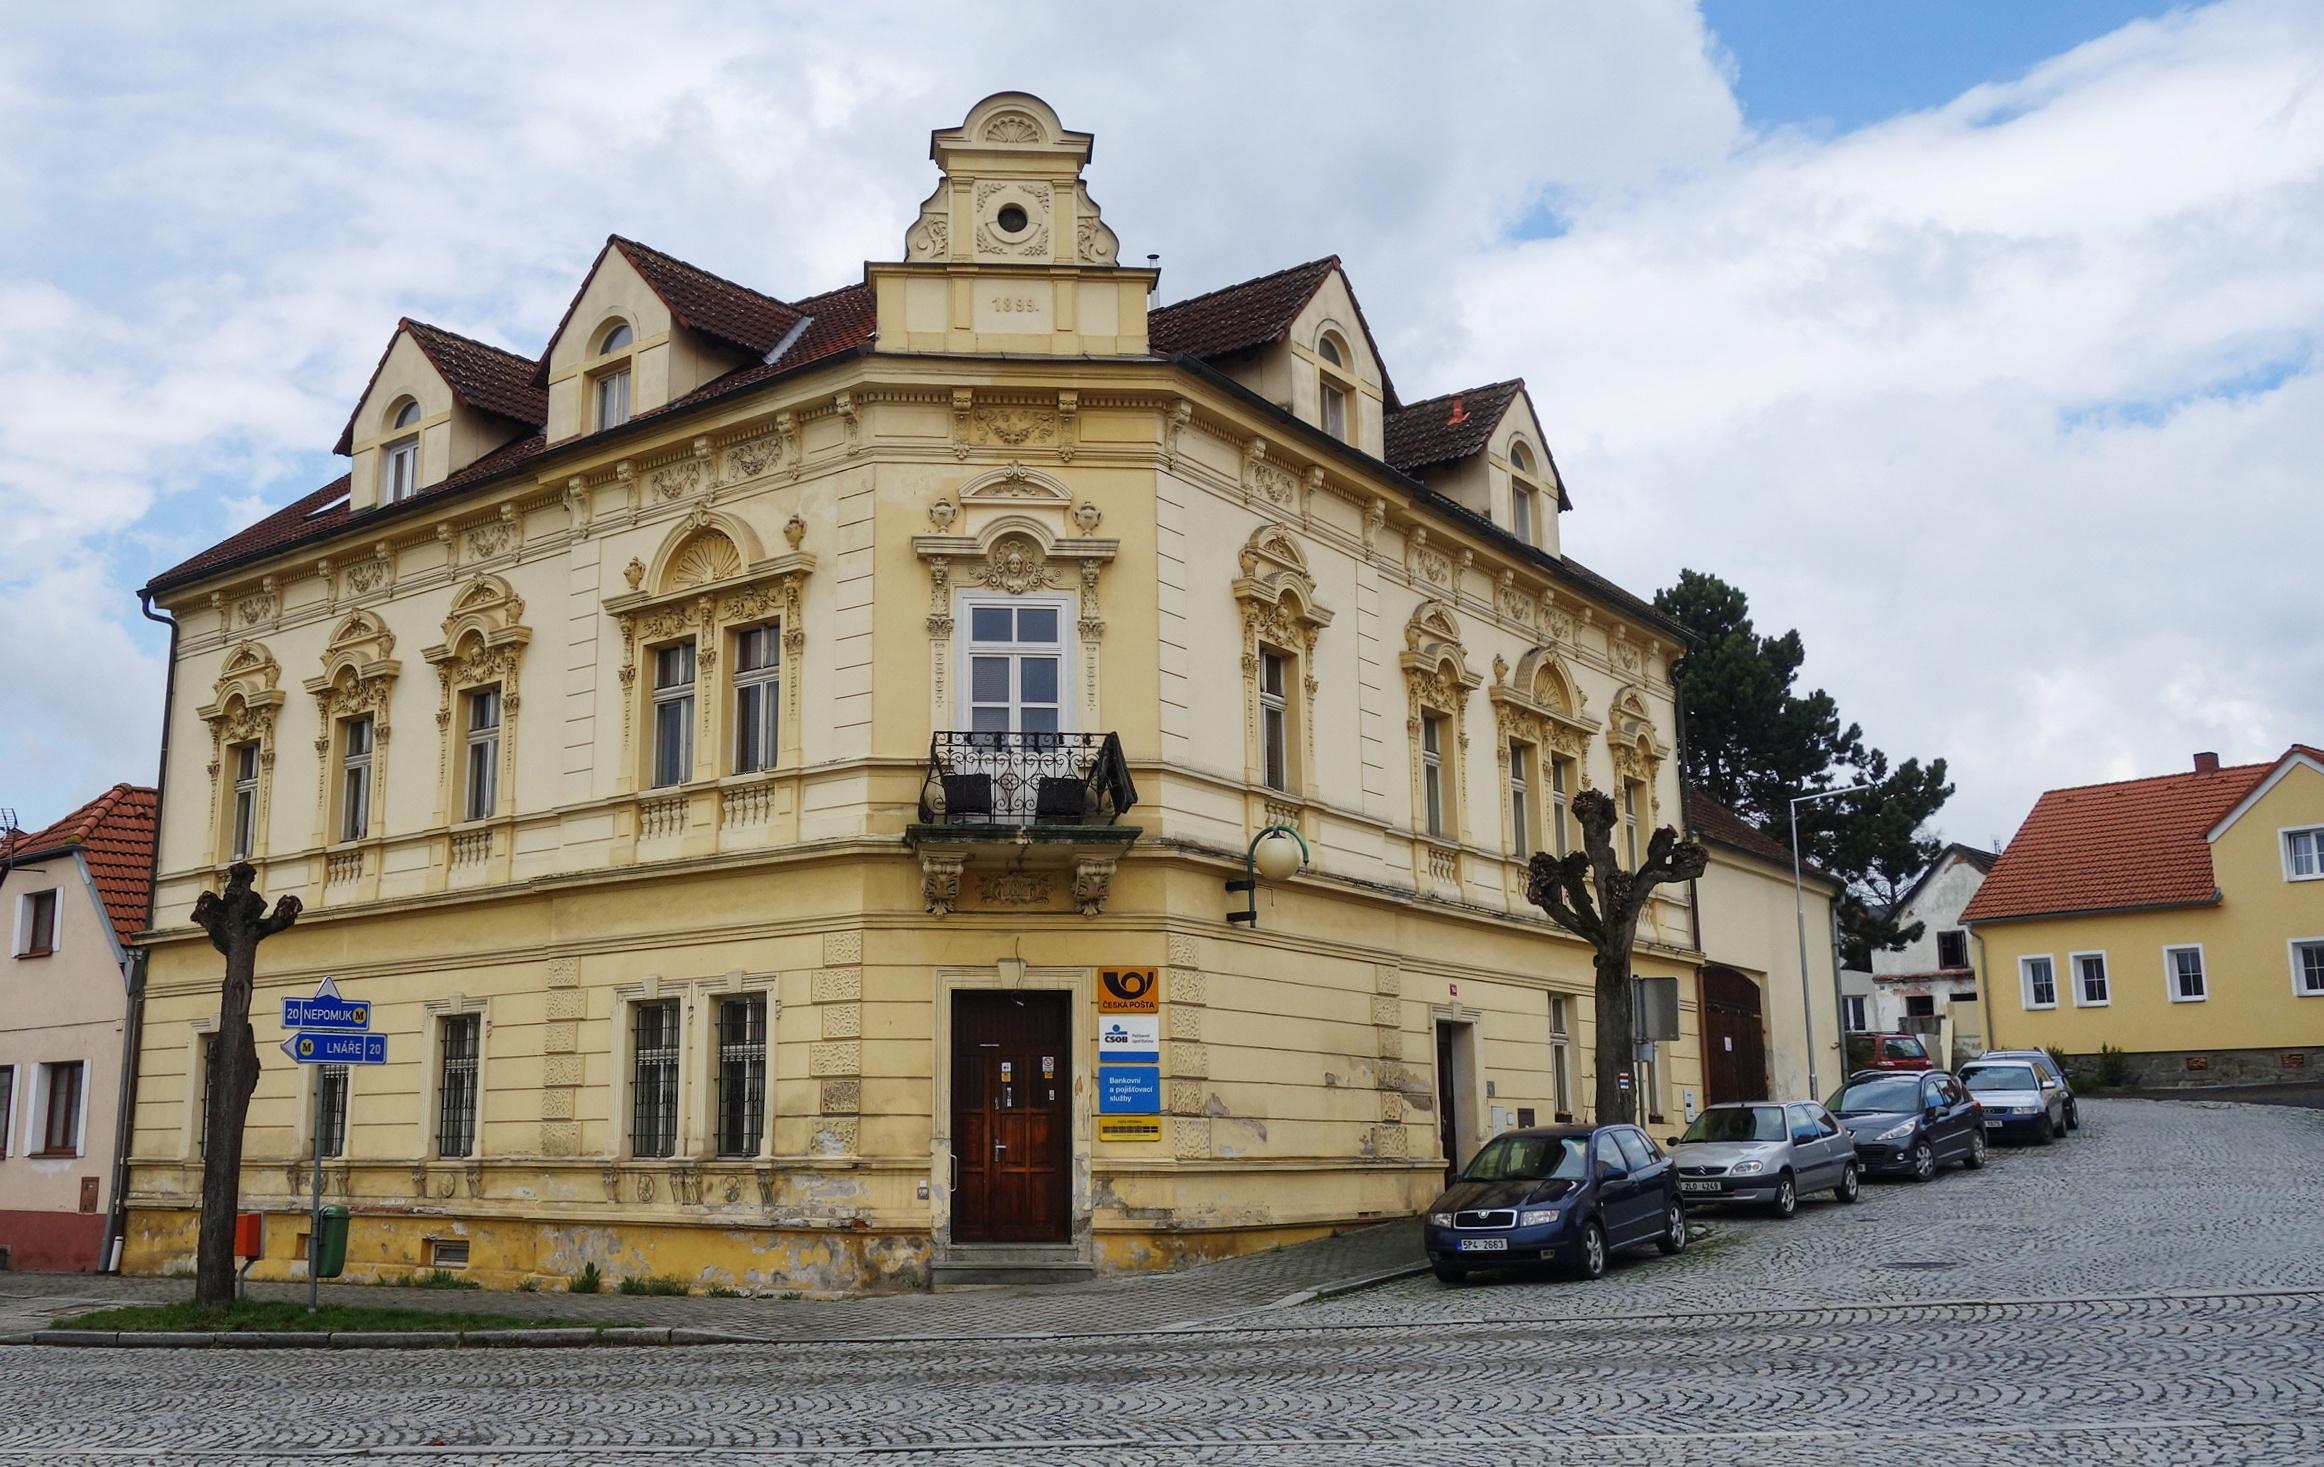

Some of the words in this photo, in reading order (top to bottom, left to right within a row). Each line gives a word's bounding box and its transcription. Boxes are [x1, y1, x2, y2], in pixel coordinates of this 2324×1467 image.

[1102, 1000, 1128, 1009] ČESKÁ
[1129, 1000, 1155, 1009] POŠTA
[287, 1008, 299, 1019] 20
[303, 1009, 353, 1021] NEPOMUK
[1104, 1035, 1128, 1043] ČSOB
[327, 1040, 362, 1054] LNÁŘE
[369, 1044, 381, 1055] 20
[1109, 1076, 1141, 1084] Bankovní
[1115, 1086, 1153, 1094] pojišťovací
[1109, 1095, 1132, 1103] služby
[1483, 1240, 1504, 1249] 2663
